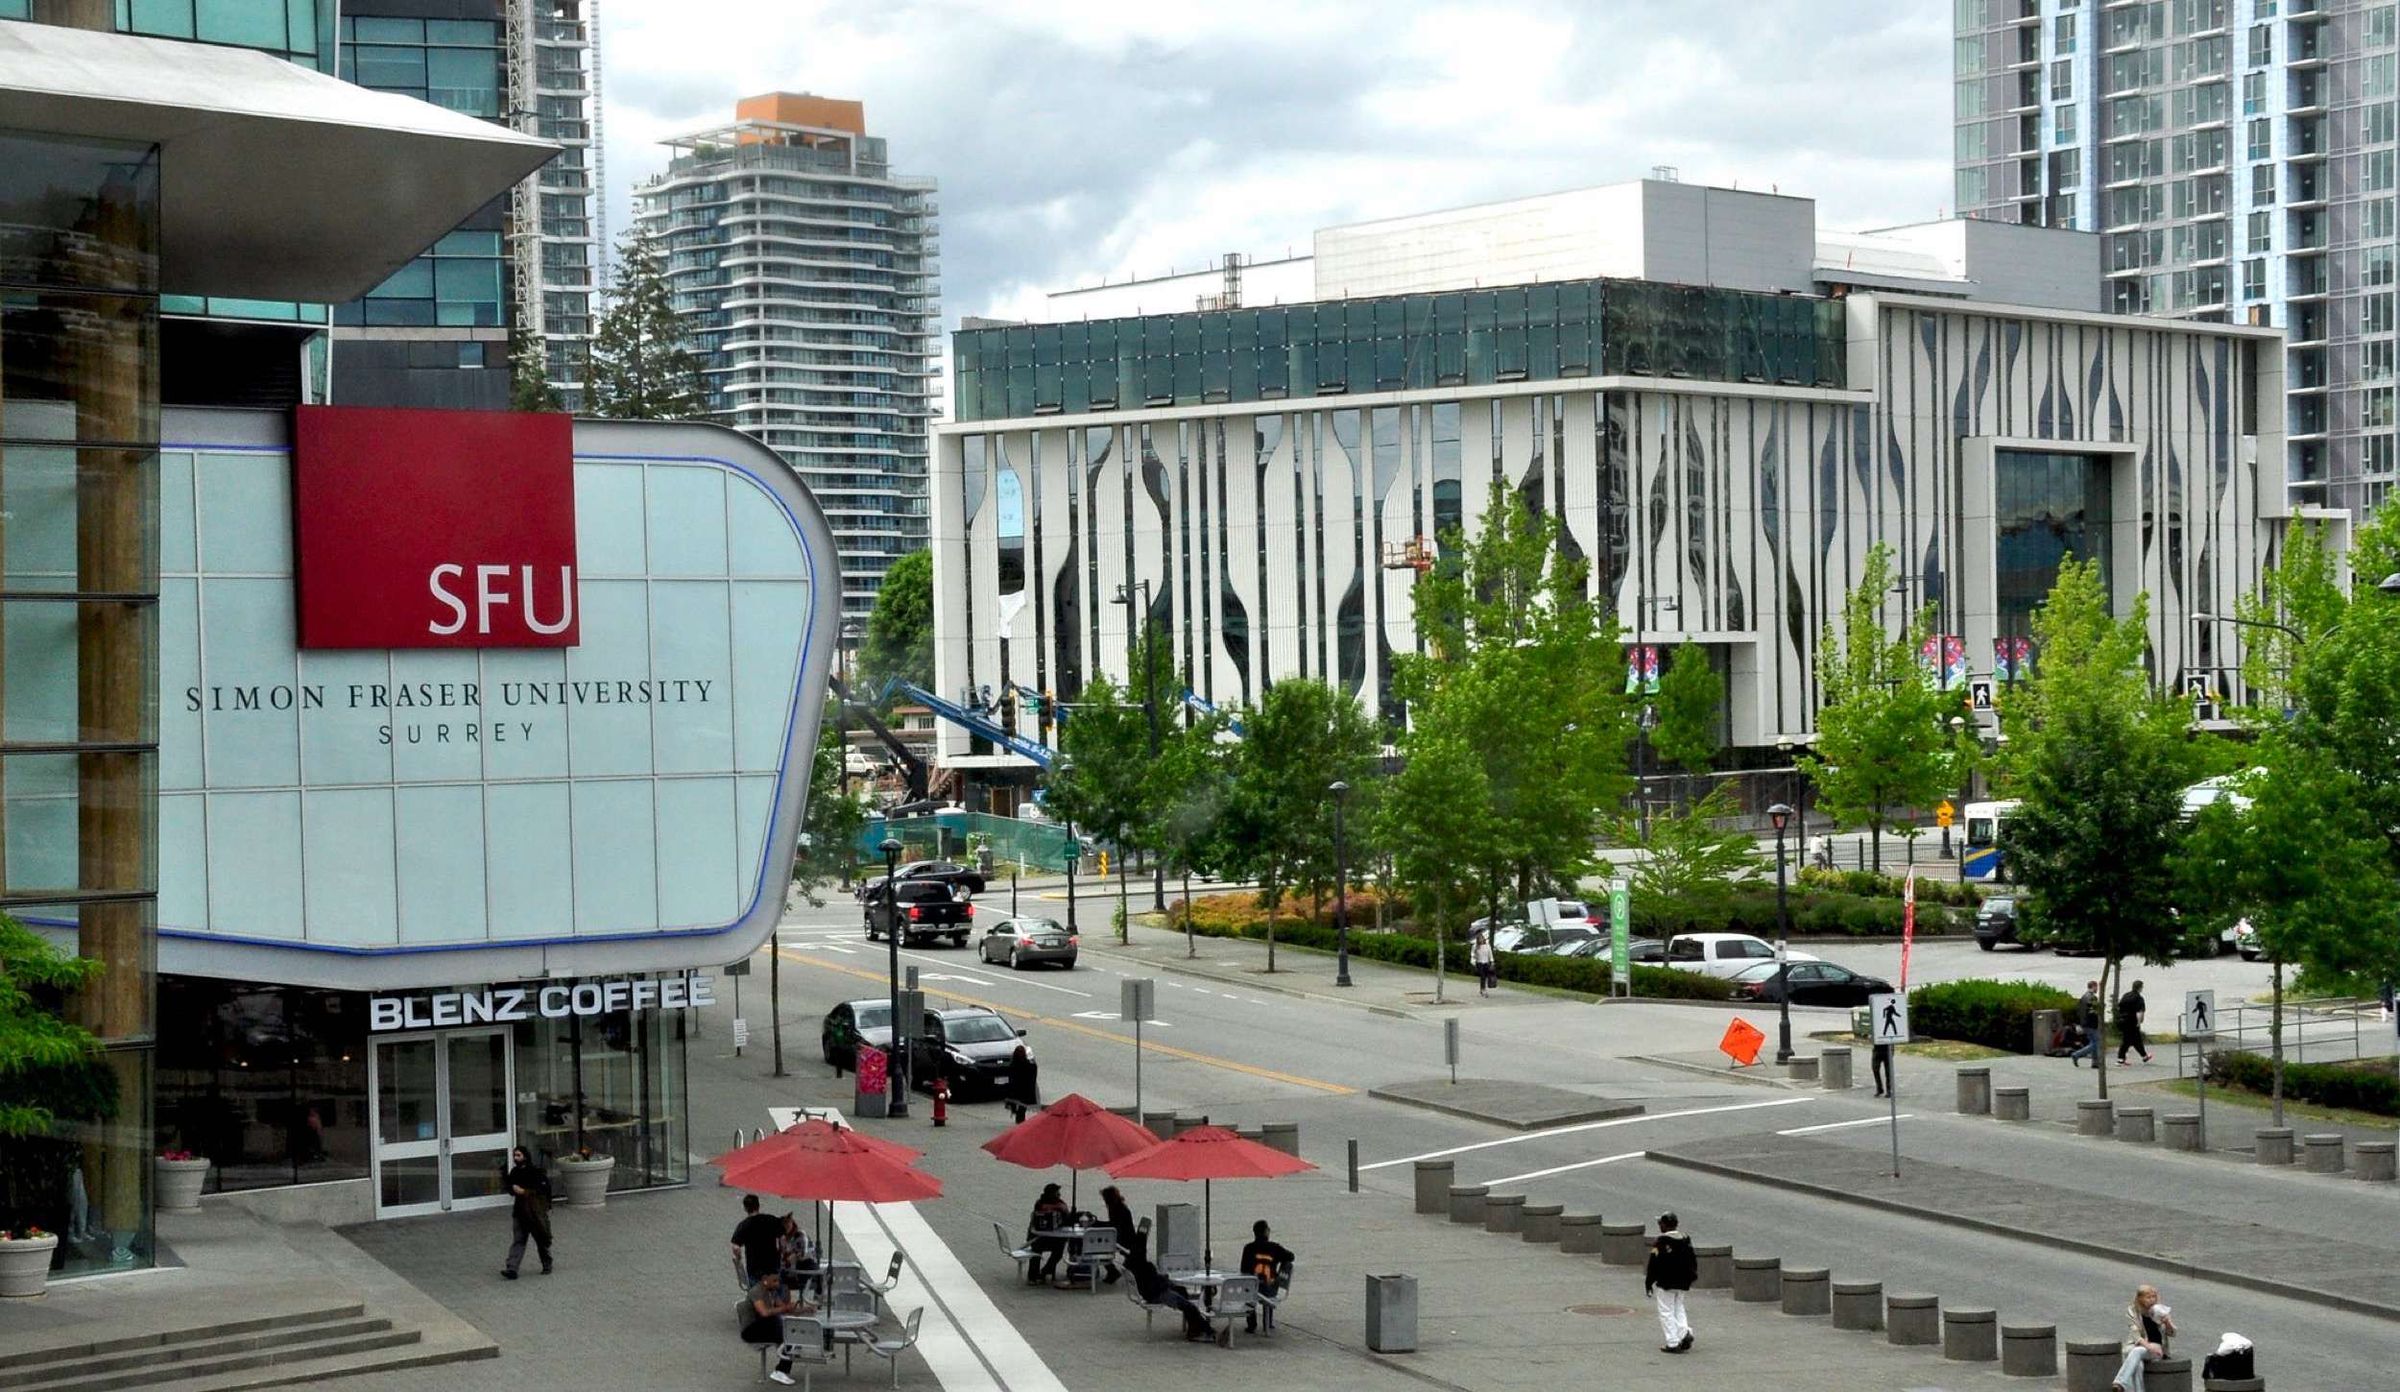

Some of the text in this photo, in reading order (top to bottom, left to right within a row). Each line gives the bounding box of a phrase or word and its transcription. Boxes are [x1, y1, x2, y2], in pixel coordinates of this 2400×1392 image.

[429, 564, 572, 634] SFU
[186, 680, 713, 713] SIMON FRASER UNIVERSITY
[379, 723, 533, 744] SURREY
[371, 976, 716, 1031] BLENZ COFFEE
